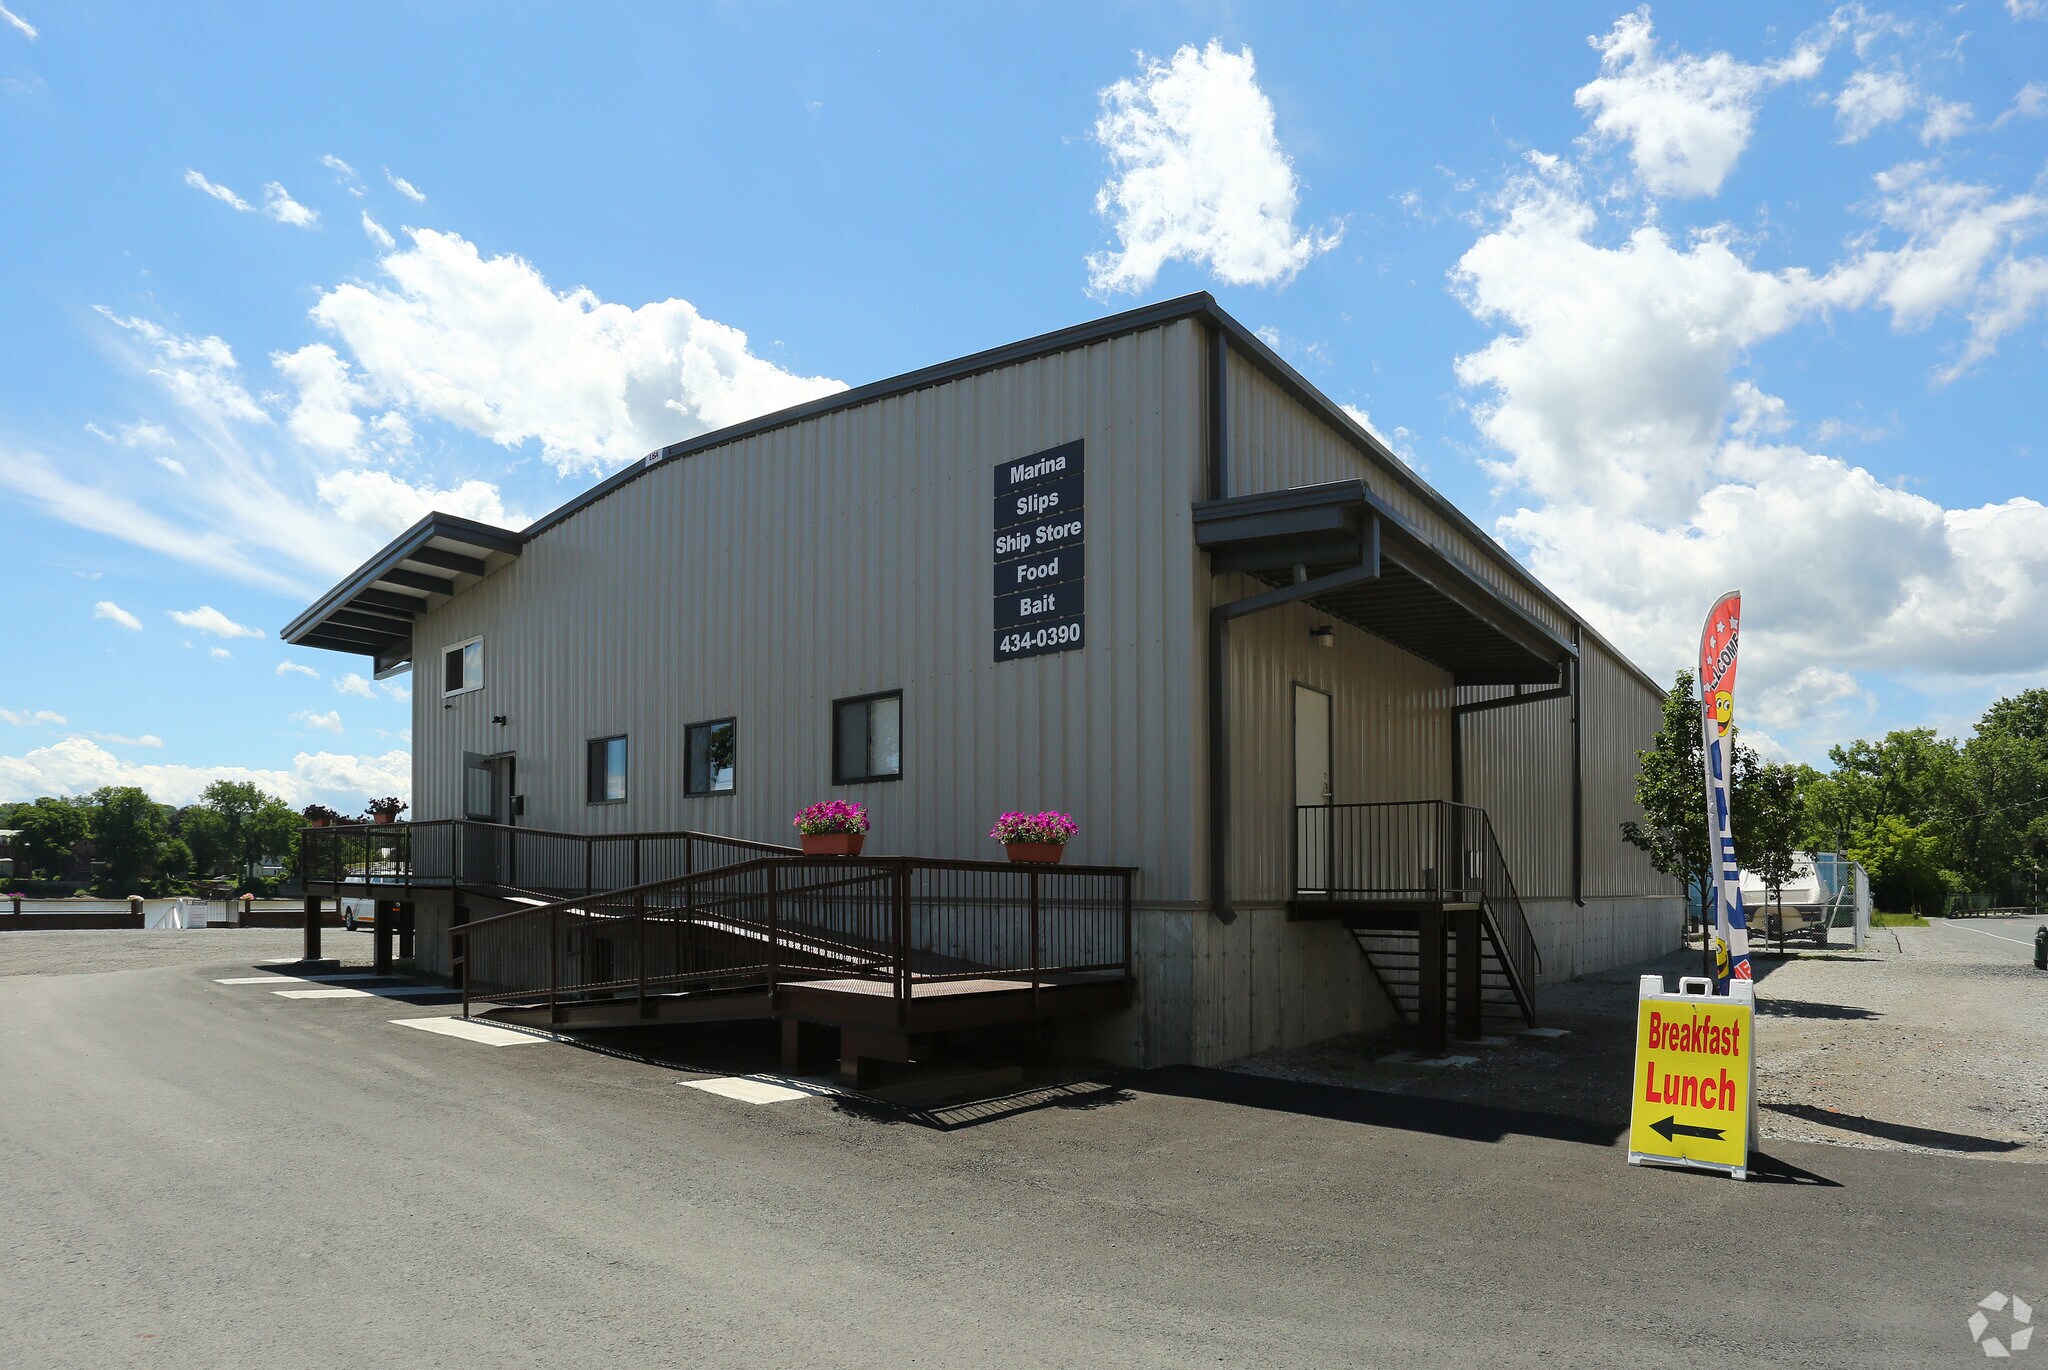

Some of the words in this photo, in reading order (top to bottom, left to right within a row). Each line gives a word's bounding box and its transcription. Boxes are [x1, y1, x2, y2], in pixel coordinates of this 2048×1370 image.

[1010, 455, 1066, 484] Marina
[1016, 491, 1059, 515] Slips
[996, 532, 1031, 555] Ship
[1035, 520, 1082, 544] Store
[1017, 557, 1059, 583] Food
[1020, 593, 1055, 617] Bait
[1000, 623, 1080, 653] 434-0390
[1648, 1011, 1740, 1057] Breakfast
[1645, 1061, 1736, 1112] Lunch
